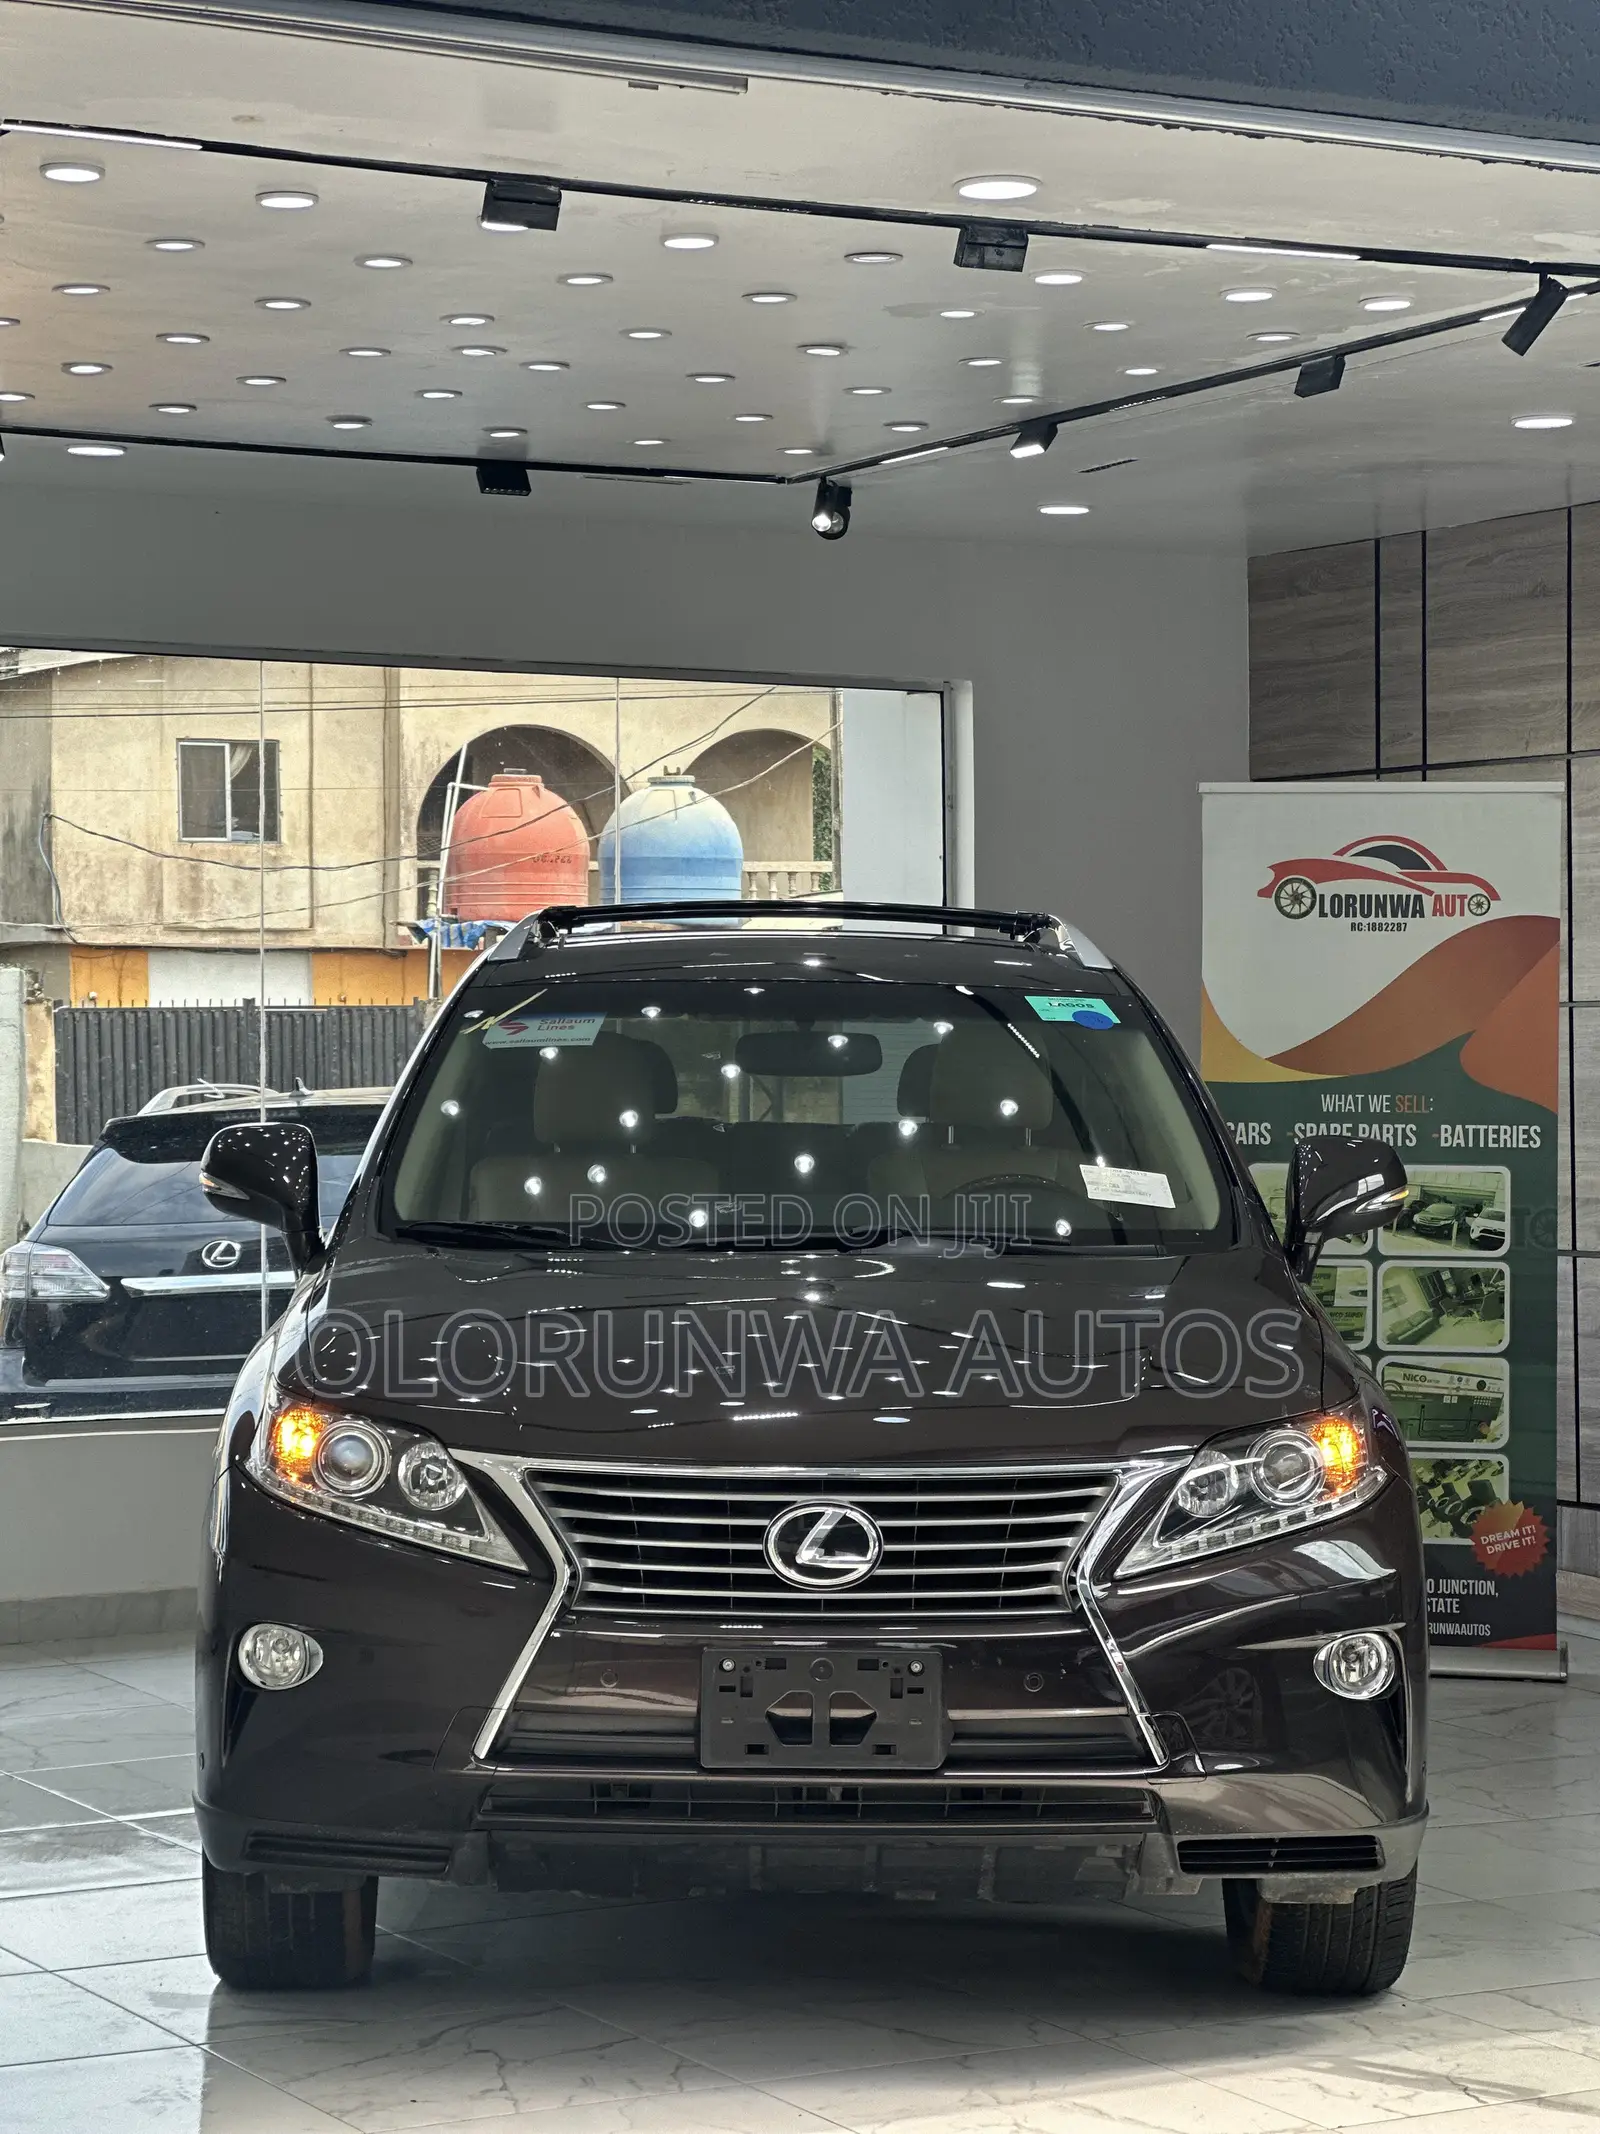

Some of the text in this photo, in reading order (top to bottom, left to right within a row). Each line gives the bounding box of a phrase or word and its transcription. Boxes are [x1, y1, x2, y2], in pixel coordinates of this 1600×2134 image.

[1350, 922, 1407, 932] RC:1882287
[539, 1017, 595, 1025] Sallaum
[1321, 1094, 1433, 1113] WHAT WE SELL:
[1480, 1525, 1536, 1545] DREAM IT!
[1486, 1536, 1536, 1554] DRIVE IT!
[1437, 1579, 1499, 1597] JUNCTION,
